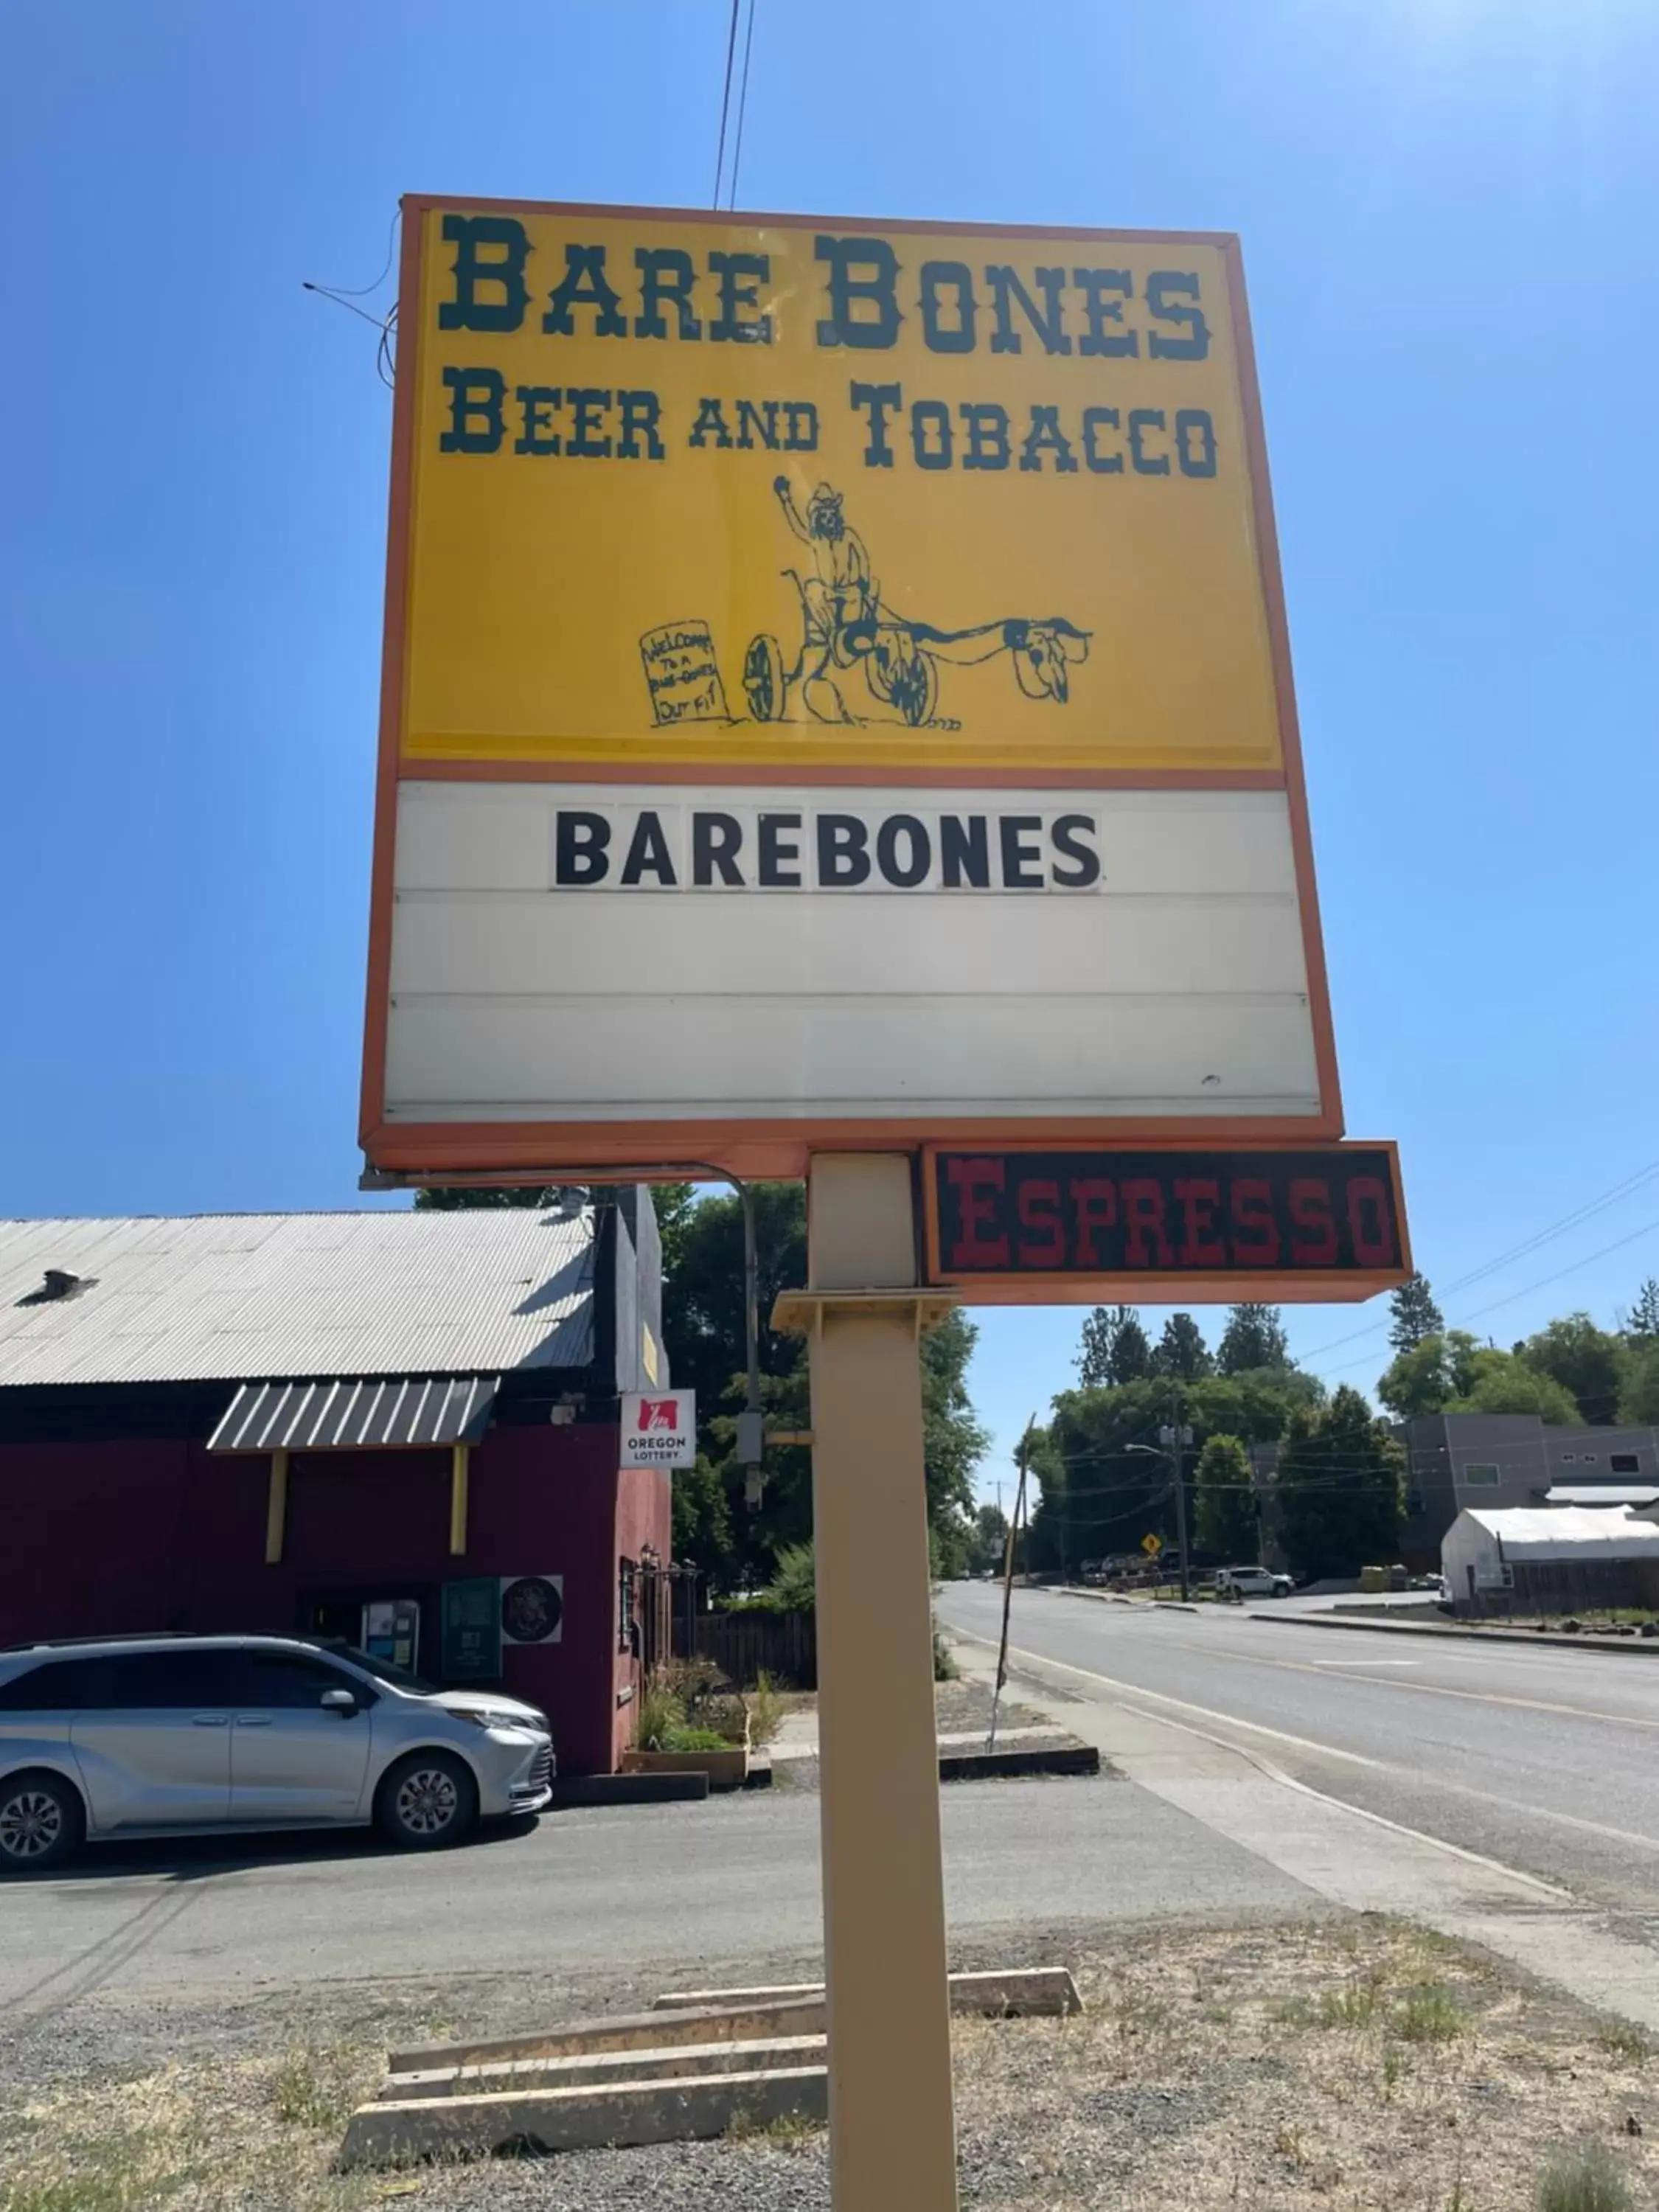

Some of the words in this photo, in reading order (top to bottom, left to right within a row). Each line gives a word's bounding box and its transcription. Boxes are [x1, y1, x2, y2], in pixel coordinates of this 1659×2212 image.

[437, 214, 772, 344] BARE
[814, 234, 1209, 361] BONES
[439, 366, 665, 460] BEER
[689, 399, 818, 451] AND
[850, 380, 1217, 478] TOBACCO
[555, 811, 1101, 888] BAREBONES
[947, 1158, 1395, 1267] ESPRESSO
[627, 1438, 686, 1450] OREGON
[634, 1451, 678, 1461] LOTTERY
